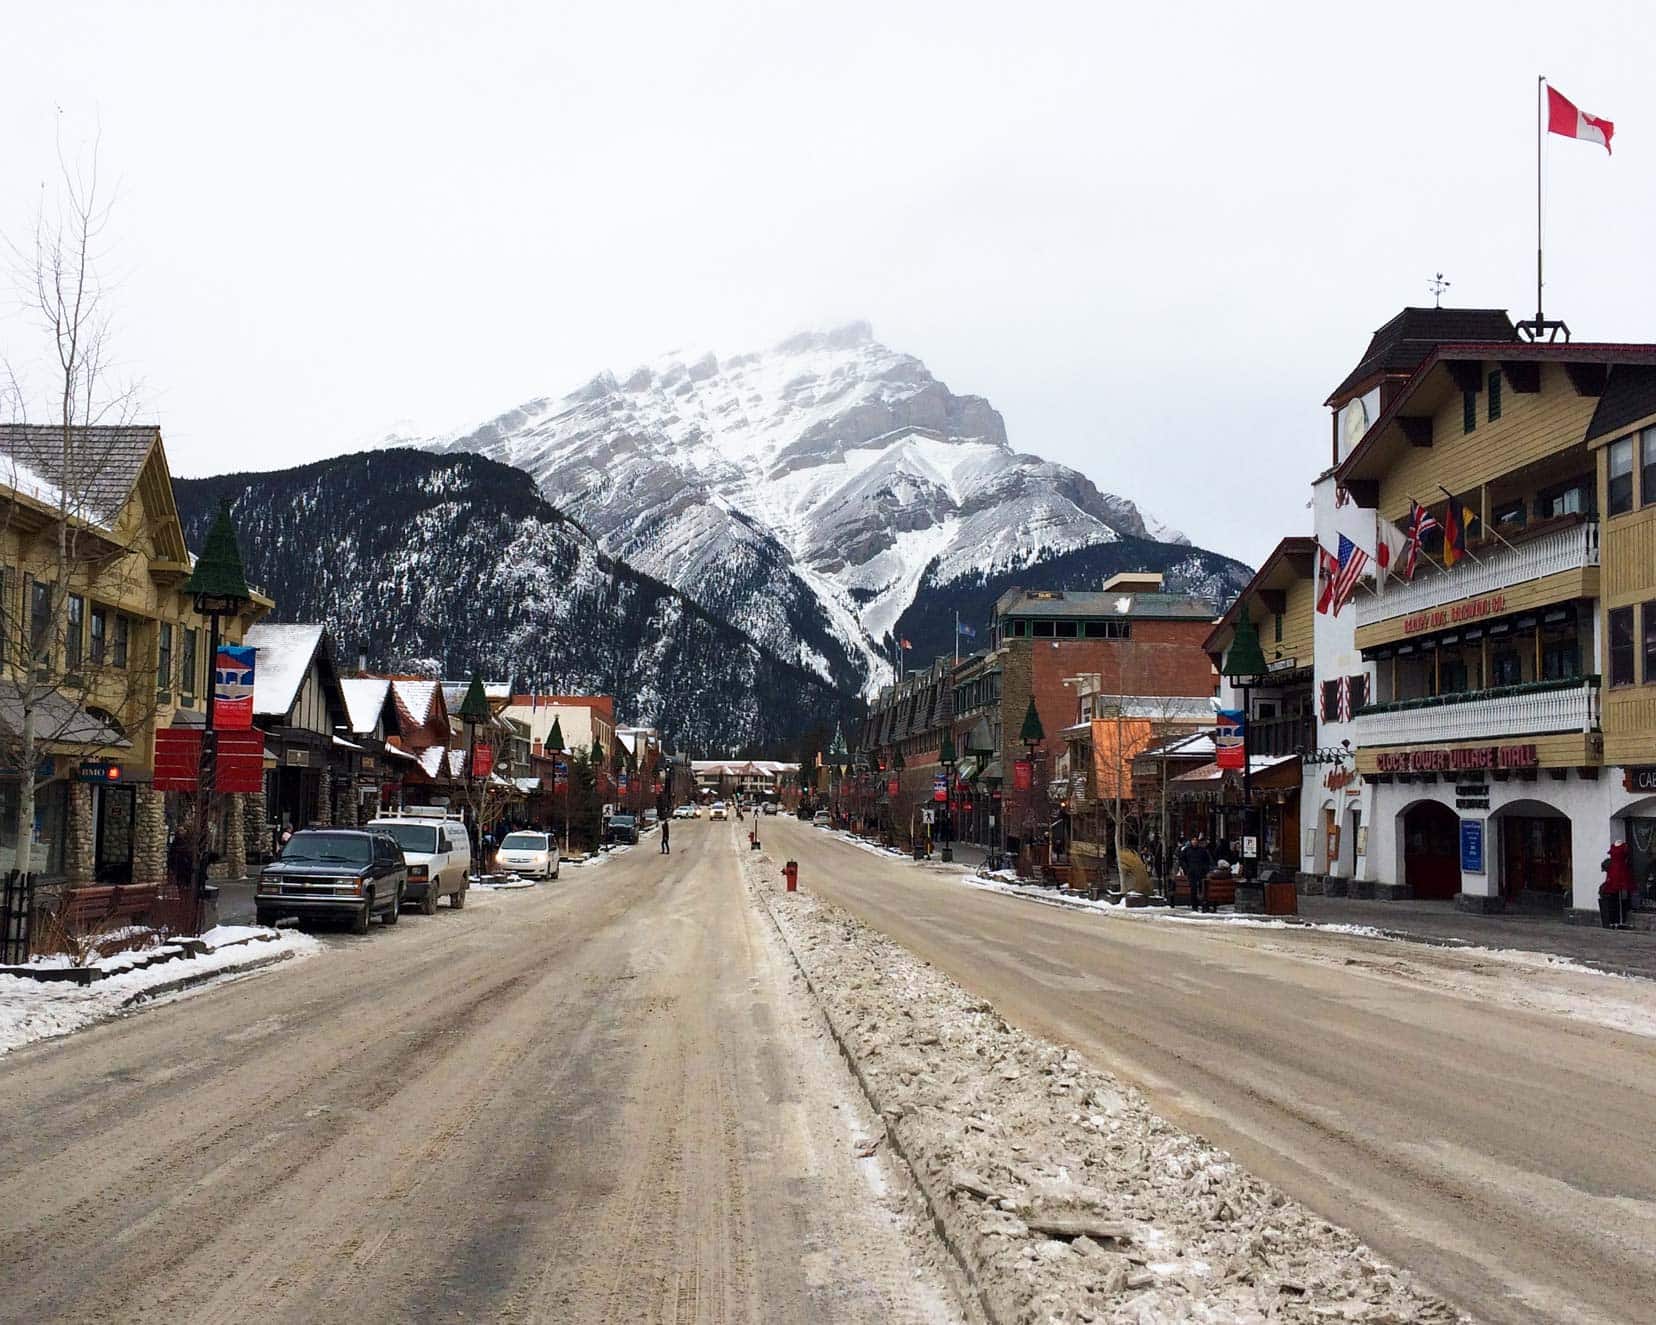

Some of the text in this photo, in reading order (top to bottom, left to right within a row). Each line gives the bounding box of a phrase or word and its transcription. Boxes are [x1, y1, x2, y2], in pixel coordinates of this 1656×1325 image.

[1376, 745, 1536, 770] CLOCK TOWER VILLAGE MALL
